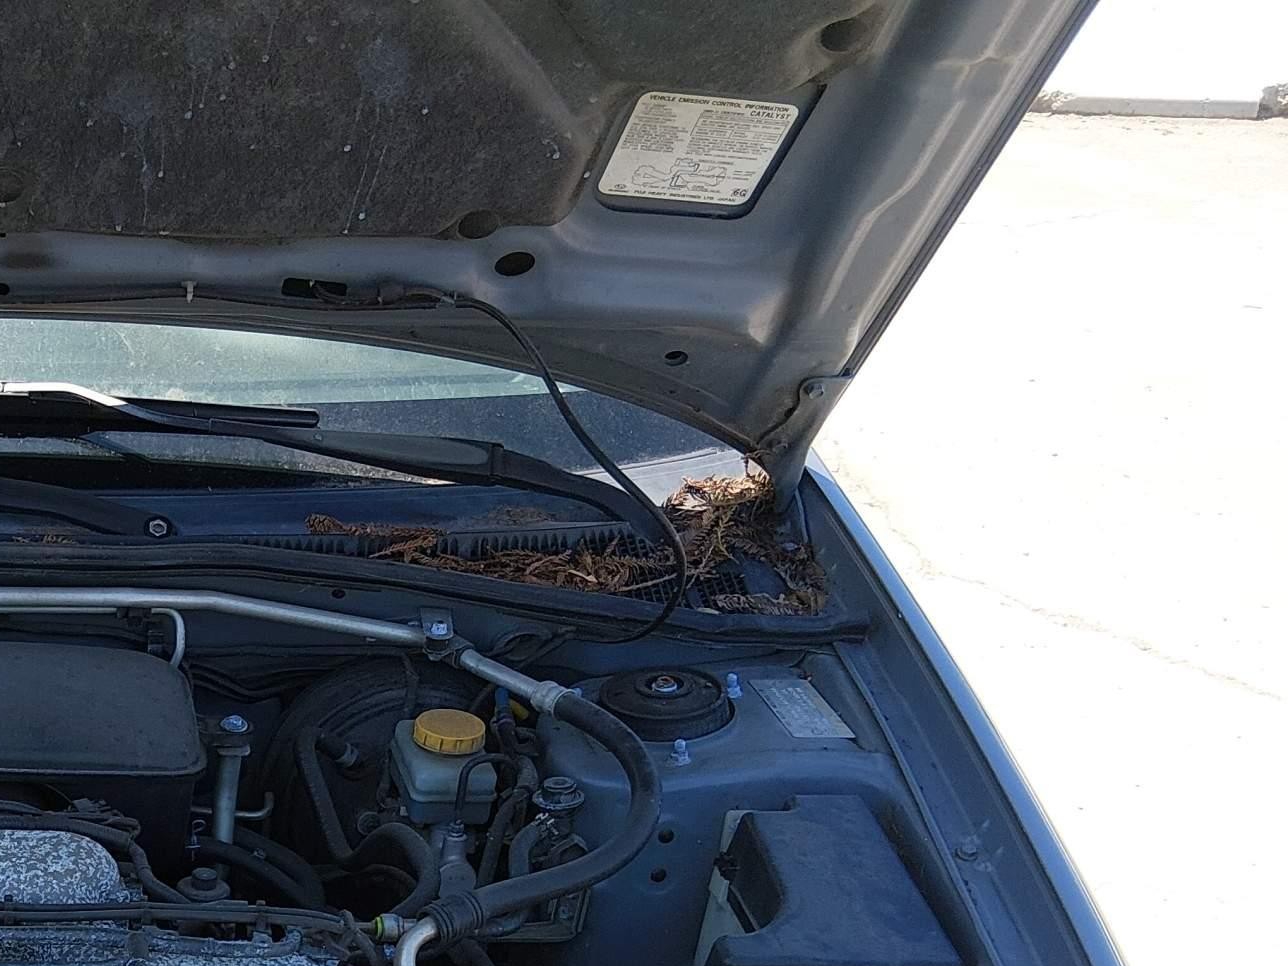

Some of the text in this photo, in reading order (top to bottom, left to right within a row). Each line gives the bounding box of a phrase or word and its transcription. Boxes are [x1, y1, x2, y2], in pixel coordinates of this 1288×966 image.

[648, 94, 790, 113] VEHICLE EMISSION CONTROL INFORMATION
[749, 110, 791, 120] CATALYST
